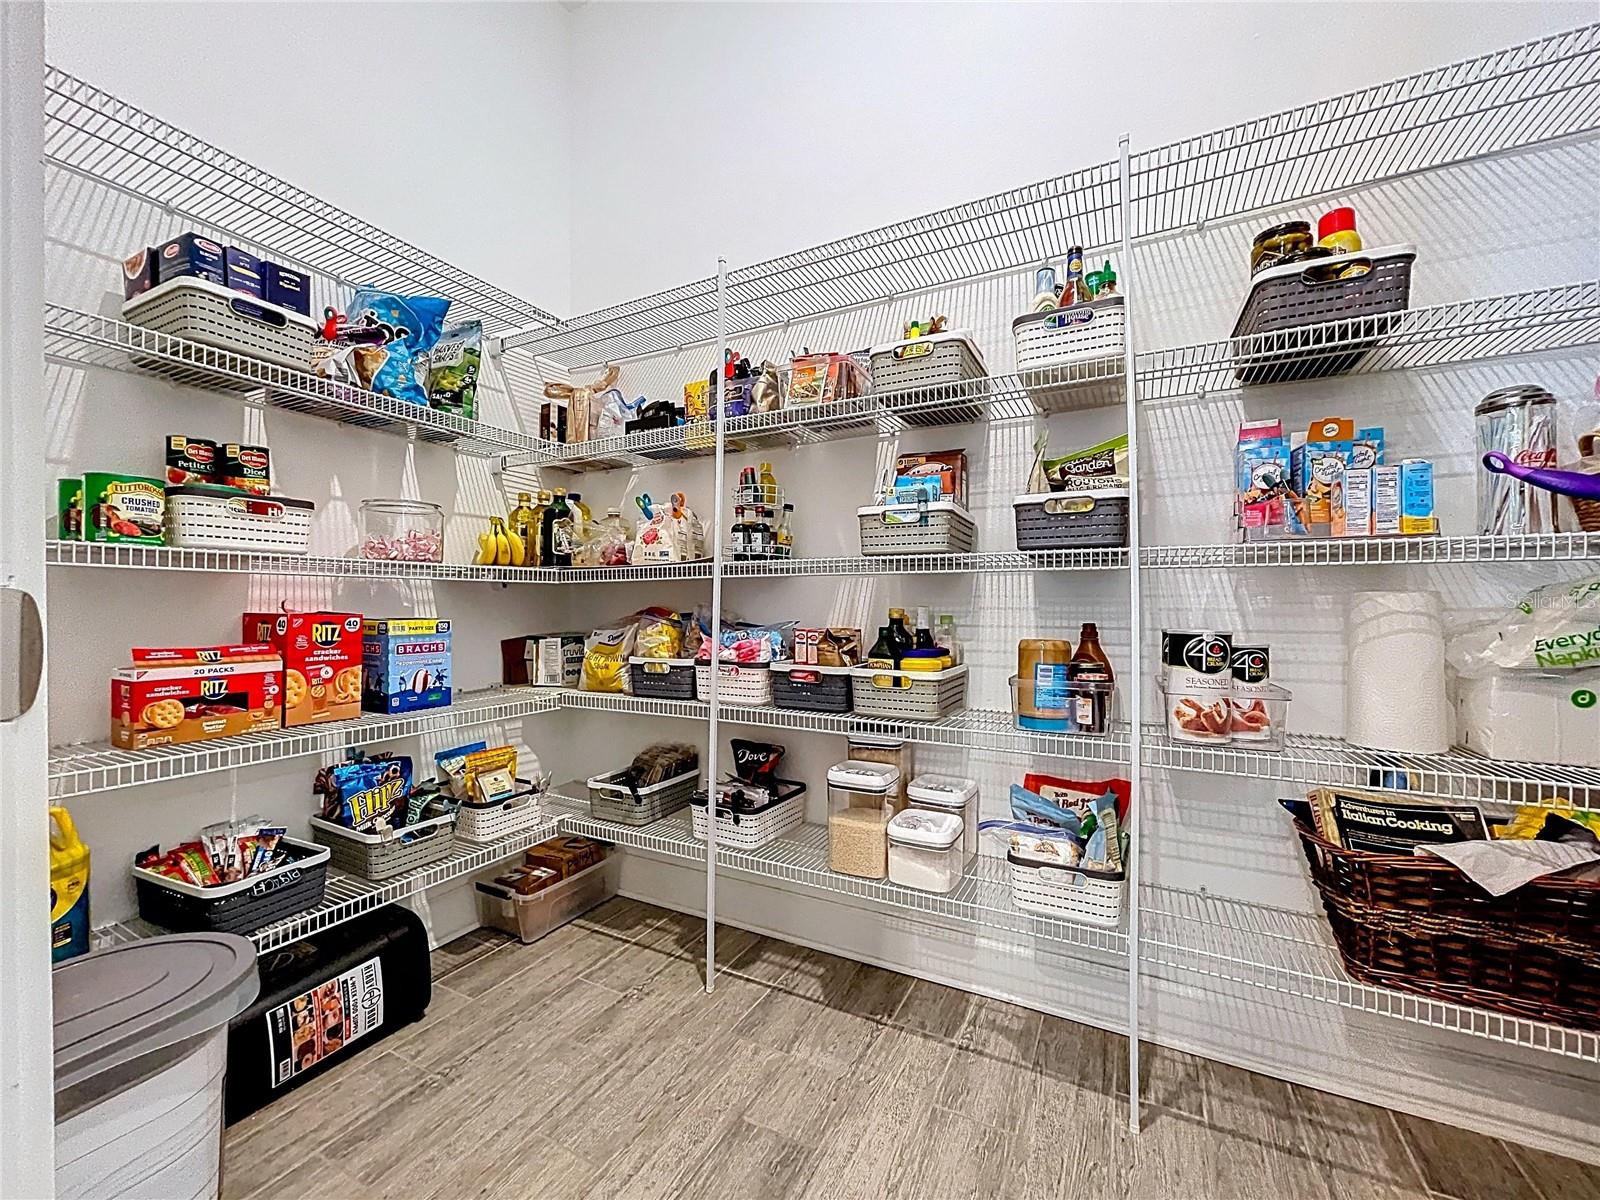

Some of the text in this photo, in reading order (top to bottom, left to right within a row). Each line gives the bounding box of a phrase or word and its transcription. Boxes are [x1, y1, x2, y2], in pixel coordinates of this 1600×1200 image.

[178, 460, 206, 470] Petite
[1064, 460, 1113, 474] Garden
[243, 467, 266, 476] Diced
[1065, 477, 1123, 488] ROUTONS
[121, 496, 161, 509] CRUSHED
[277, 619, 286, 629] 40
[345, 619, 359, 627] 40
[256, 622, 272, 641] RITZ
[312, 623, 342, 643] RITZ
[196, 650, 223, 662] RITZ
[304, 654, 349, 662] sandwiches
[313, 648, 342, 656] cracker
[1188, 641, 1224, 672] 4C
[207, 666, 235, 675] PACKS
[146, 689, 190, 698] sandwiches
[201, 679, 229, 696] RITZ
[737, 748, 768, 763] Dove
[348, 779, 403, 825] Flipz
[1062, 798, 1079, 808] Red
[1340, 801, 1397, 817] Adventures in
[1340, 808, 1387, 827] Italian
[1386, 816, 1454, 836] Cooking
